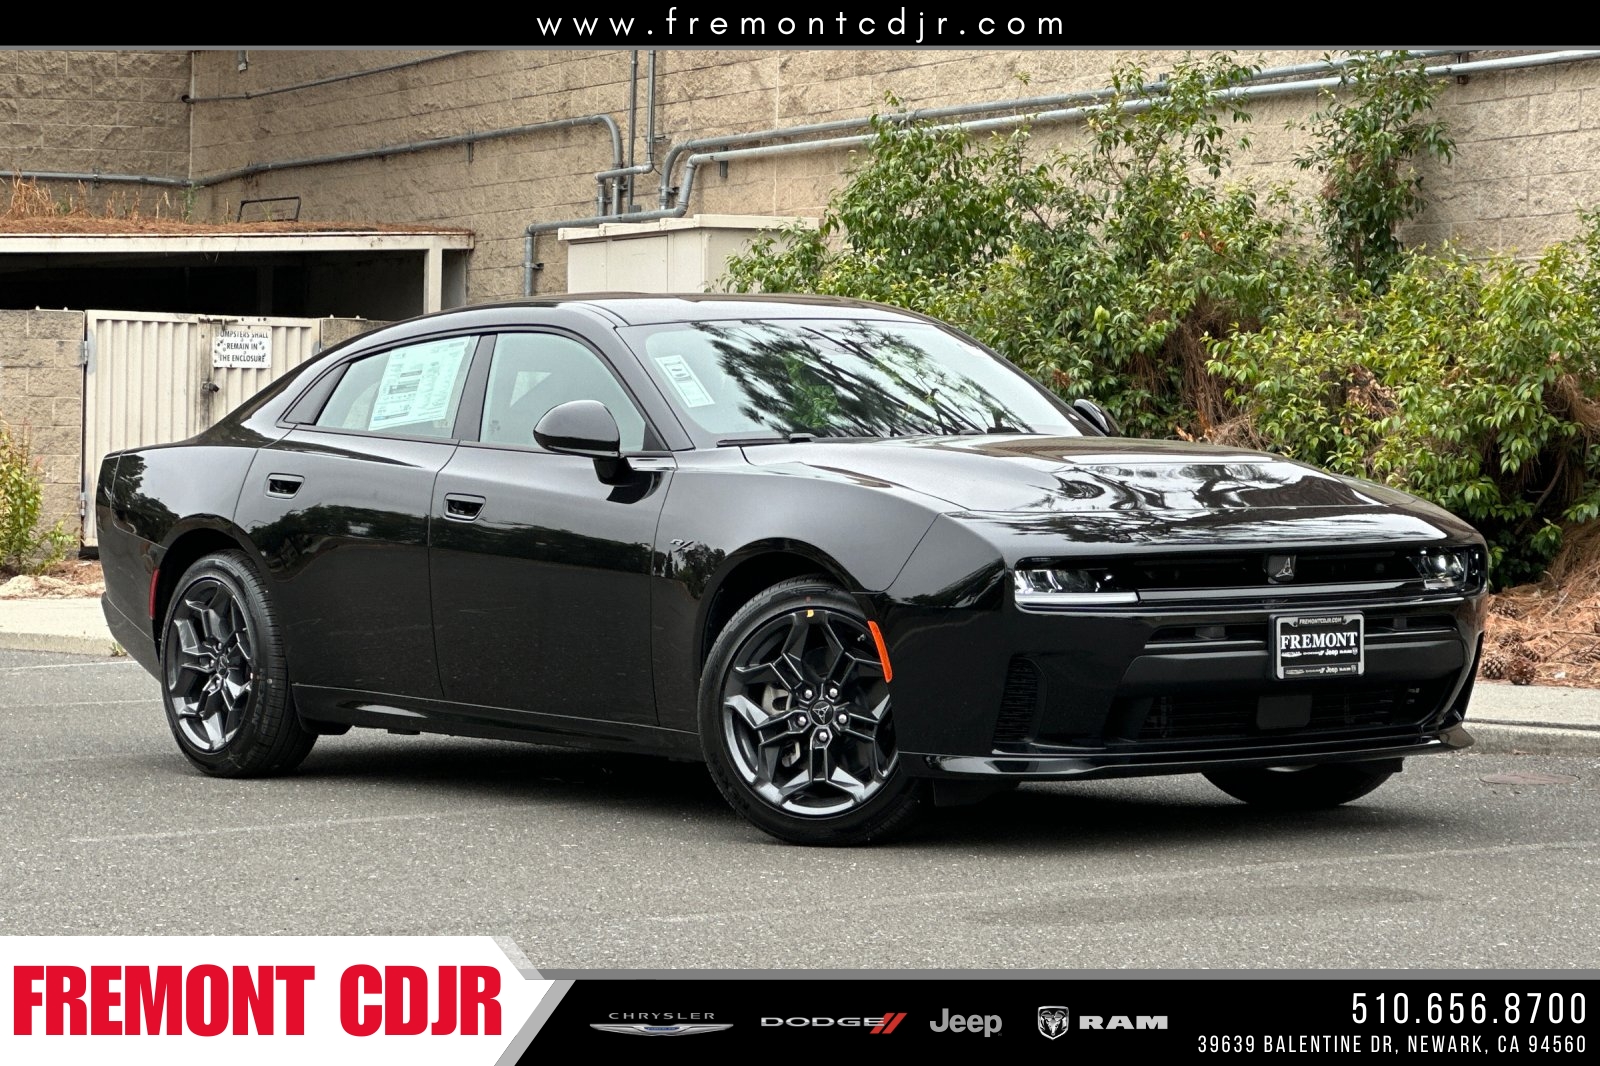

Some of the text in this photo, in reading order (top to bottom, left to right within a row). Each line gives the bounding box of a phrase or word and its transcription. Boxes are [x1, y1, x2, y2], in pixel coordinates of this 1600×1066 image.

[226, 342, 250, 350] REMAIN
[219, 354, 265, 363] THE ENCLOSURE
[1281, 632, 1358, 650] FREMONT
